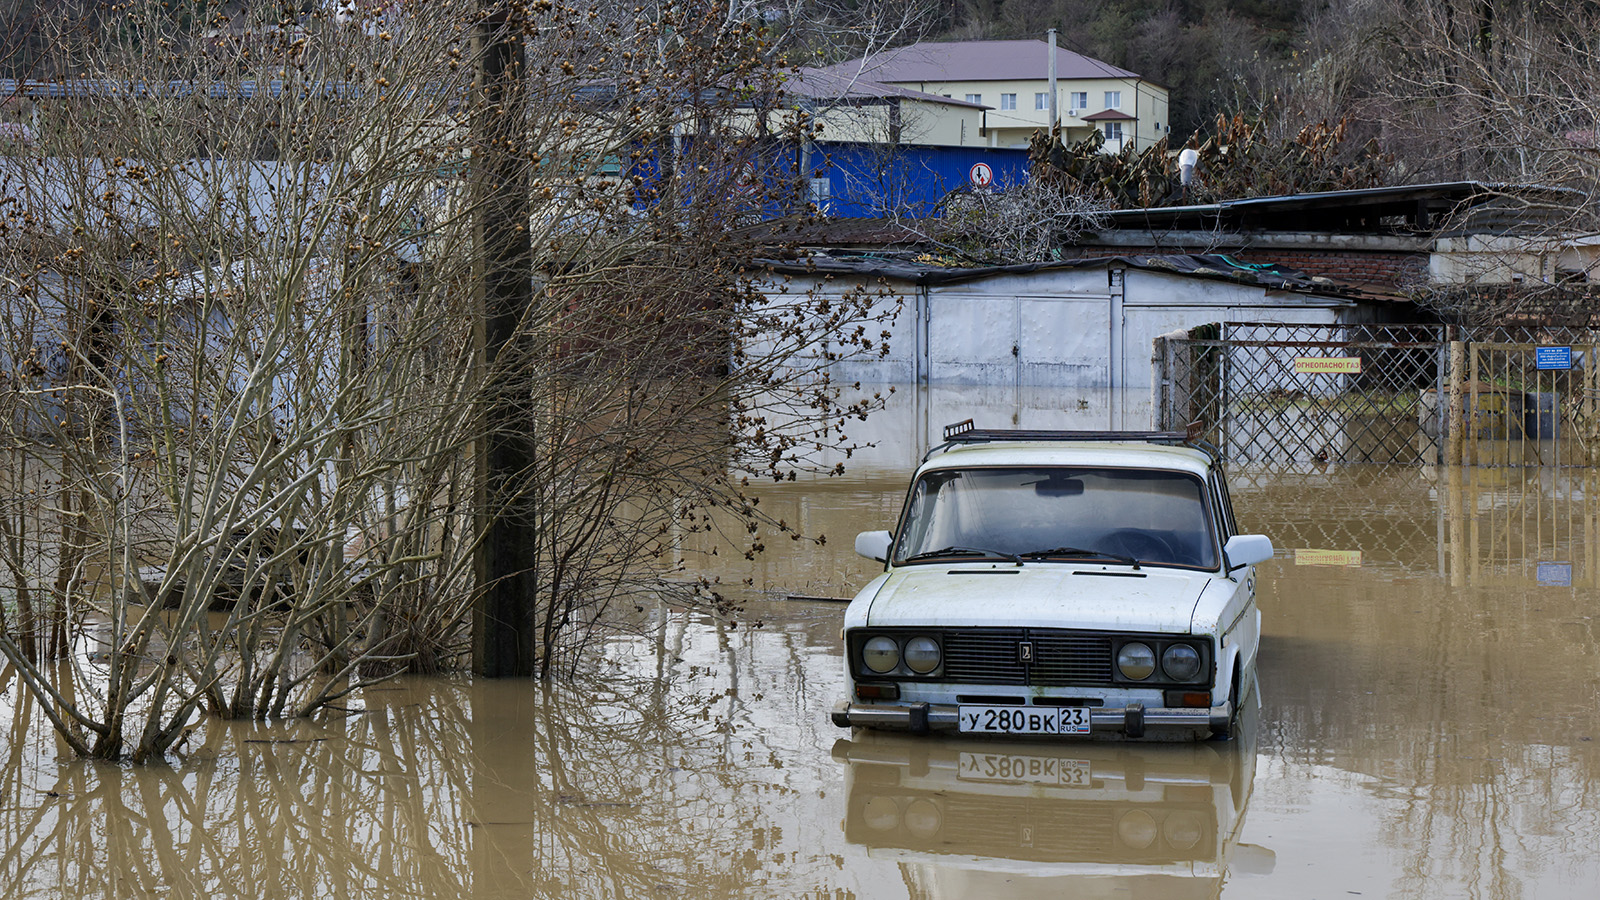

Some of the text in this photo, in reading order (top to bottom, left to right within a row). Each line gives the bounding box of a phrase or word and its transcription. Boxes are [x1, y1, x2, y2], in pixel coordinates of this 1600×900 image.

[1296, 361, 1359, 369] ОГНЕОПАСНО! ГАЗ
[1061, 709, 1083, 725] 23
